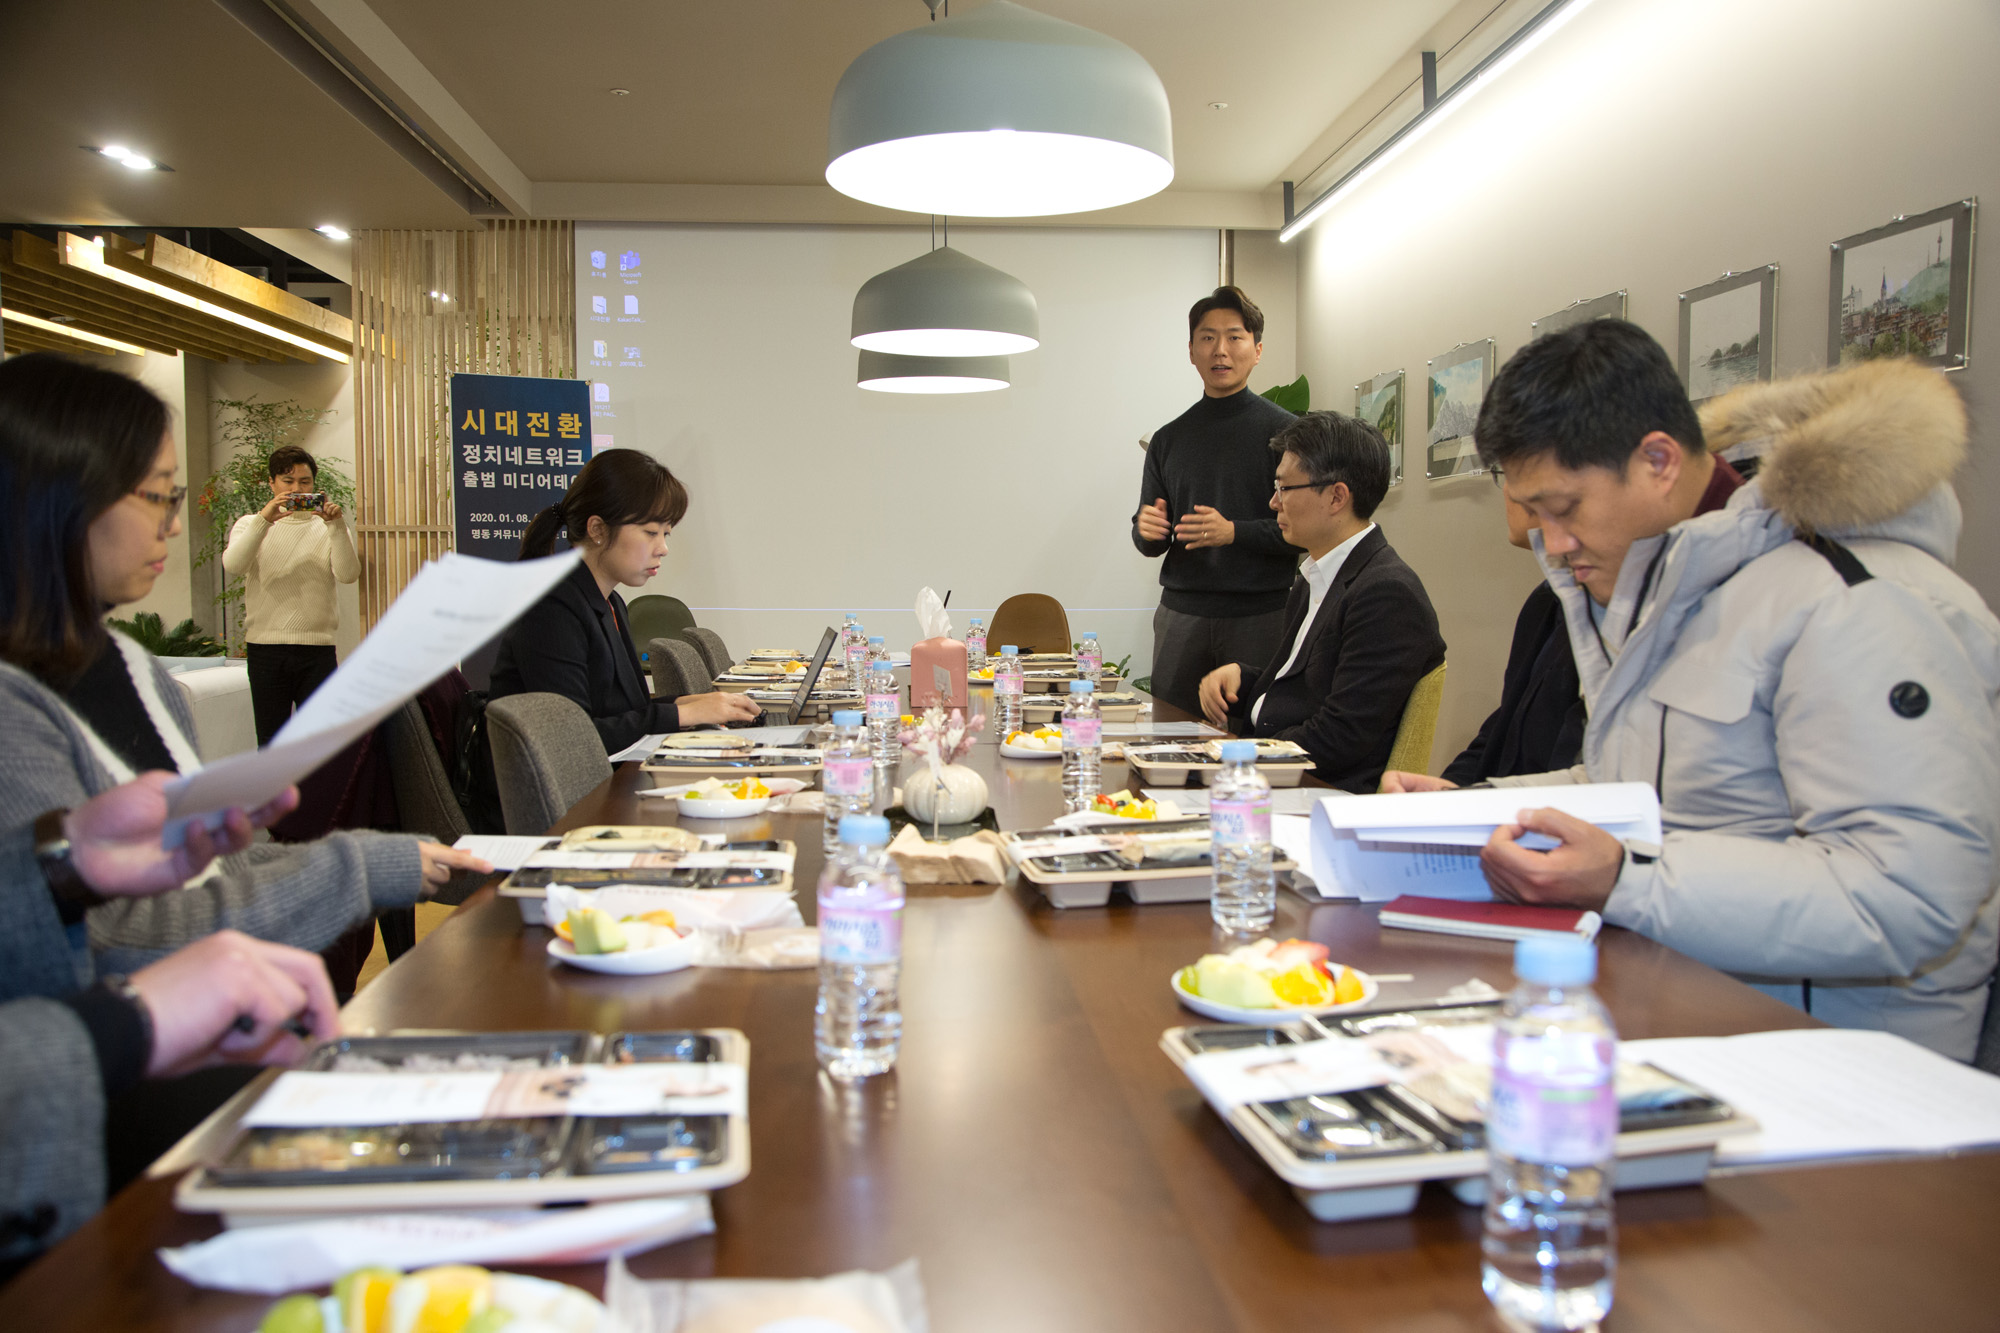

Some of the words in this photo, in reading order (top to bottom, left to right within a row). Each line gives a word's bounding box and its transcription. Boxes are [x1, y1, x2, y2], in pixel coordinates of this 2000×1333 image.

[461, 409, 583, 439] 시대전환
[462, 444, 585, 468] 정치네트워크
[462, 470, 496, 488] 출범
[503, 472, 578, 490] 미디어데
[470, 513, 497, 523] 2020.
[499, 513, 514, 523] 01.
[516, 513, 532, 523] 08.
[471, 529, 491, 540] 명동
